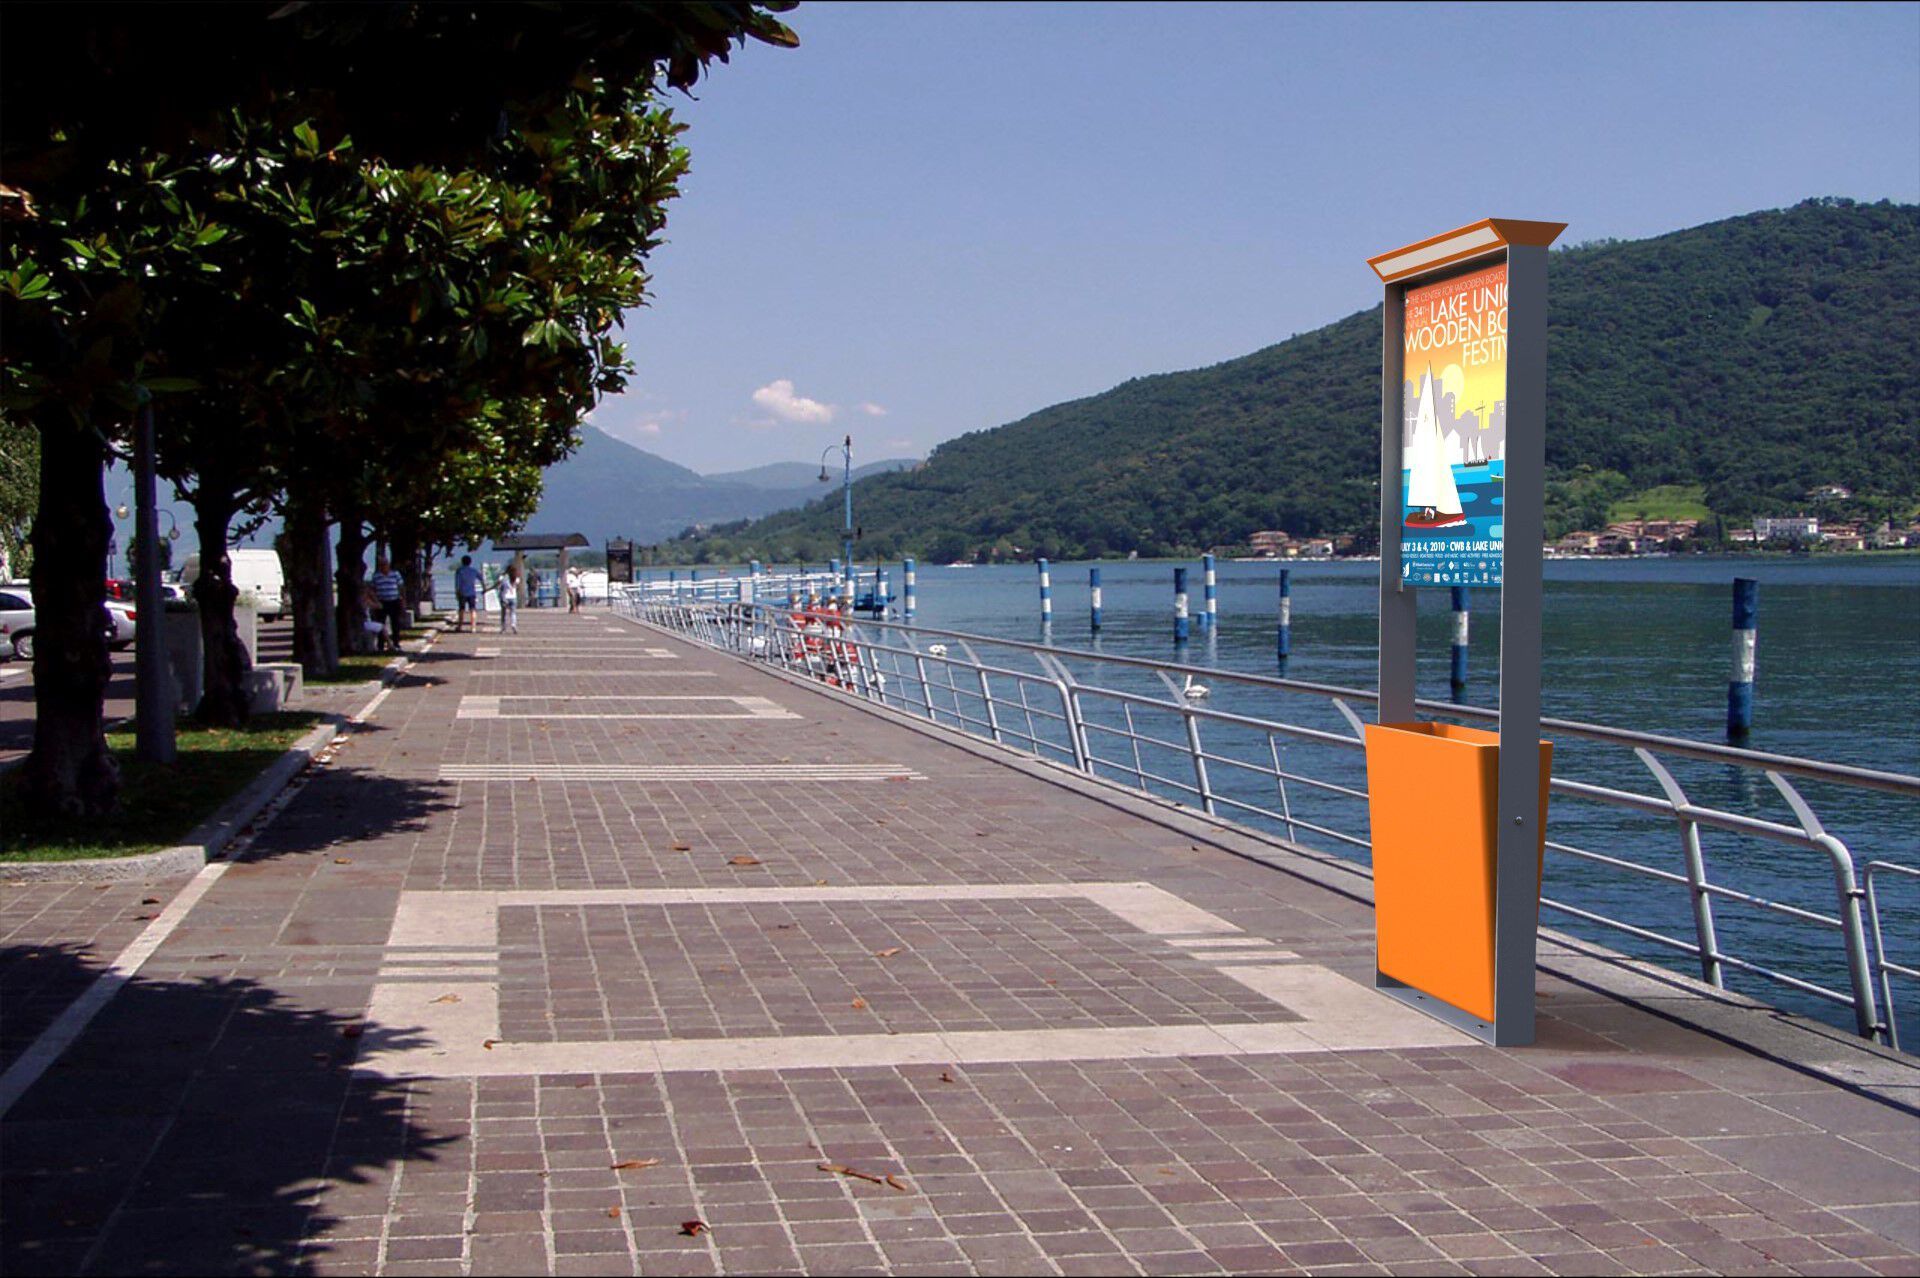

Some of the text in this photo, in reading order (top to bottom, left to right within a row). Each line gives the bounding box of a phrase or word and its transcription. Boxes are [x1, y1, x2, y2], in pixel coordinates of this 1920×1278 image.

[1452, 276, 1484, 292] WOODEN
[1486, 270, 1504, 284] BOATS
[1430, 292, 1467, 324] LAKE
[1404, 314, 1481, 353] WOODEN
[1412, 542, 1416, 552] 3
[1417, 542, 1422, 552] &
[1430, 541, 1446, 552] 2010
[1450, 541, 1464, 551] CWB
[1466, 541, 1471, 551] &
[1472, 540, 1488, 551] LAKE
